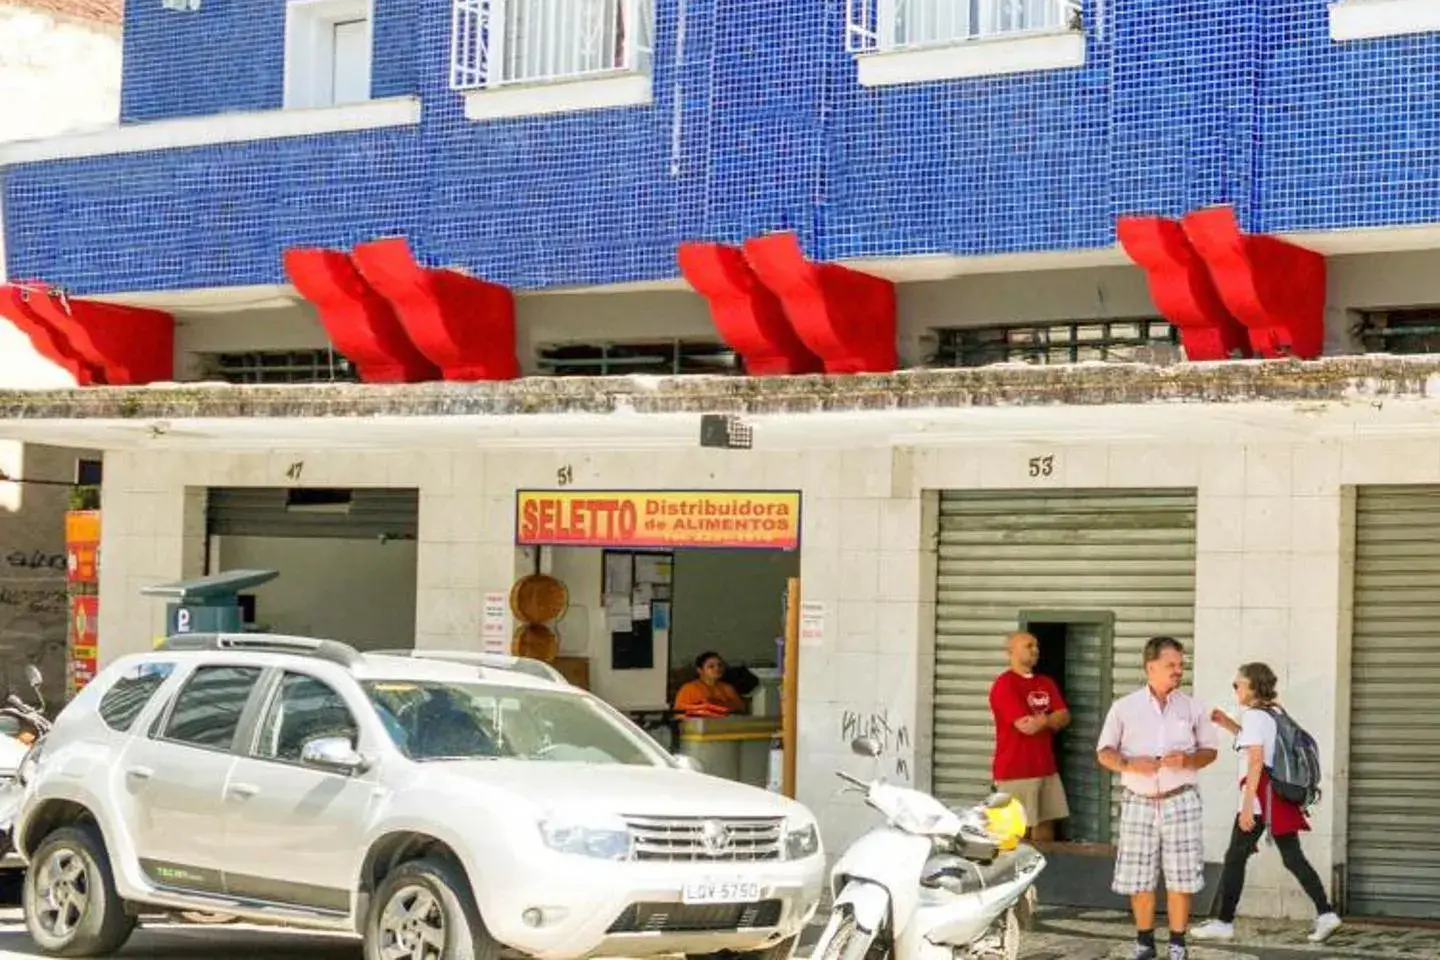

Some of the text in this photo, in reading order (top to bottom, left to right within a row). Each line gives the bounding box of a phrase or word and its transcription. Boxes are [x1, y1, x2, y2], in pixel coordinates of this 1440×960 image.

[1028, 455, 1054, 477] 53
[645, 499, 789, 516] Distribuidora
[523, 498, 637, 541] SELETTO
[645, 517, 789, 531] de ALIMENTOS
